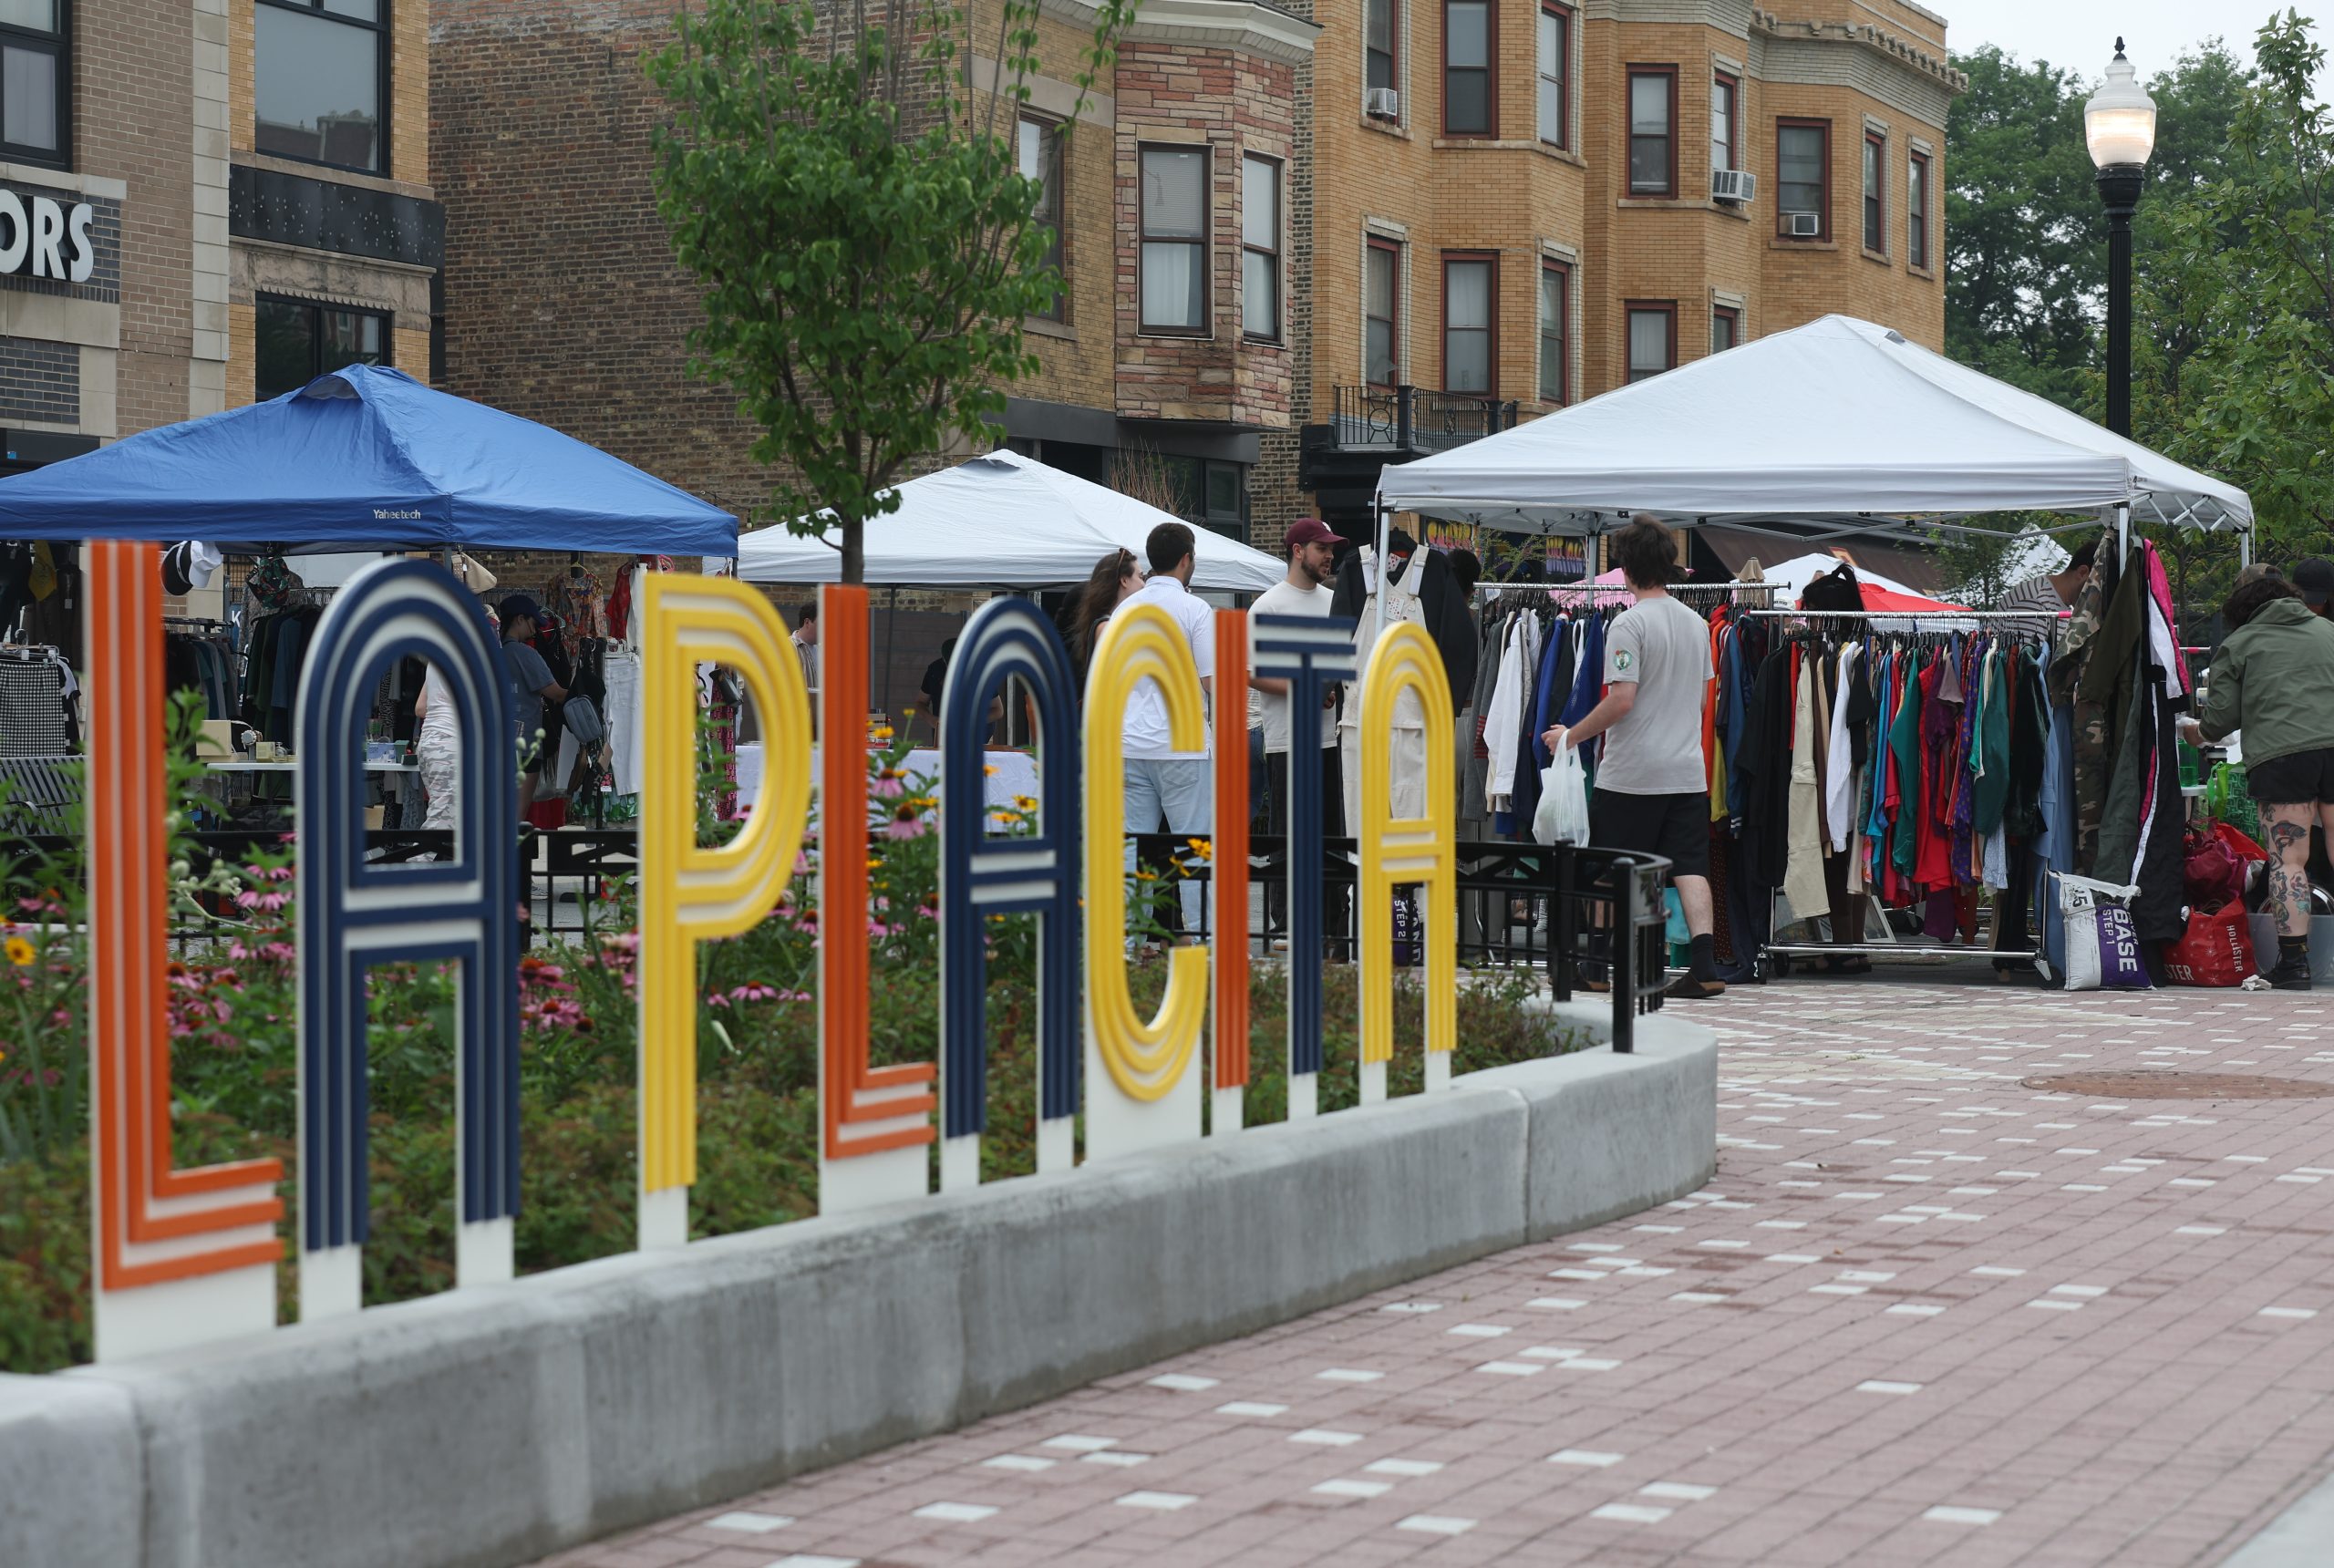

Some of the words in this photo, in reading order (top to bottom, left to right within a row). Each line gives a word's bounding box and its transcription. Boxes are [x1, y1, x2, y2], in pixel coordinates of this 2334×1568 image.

[0, 189, 94, 283] ORS
[373, 509, 421, 520] Yaheetech
[1398, 930, 1406, 938] 2
[2102, 908, 2114, 936] STEP
[2112, 908, 2138, 972] BASE
[2226, 924, 2244, 973] HOLLISTER
